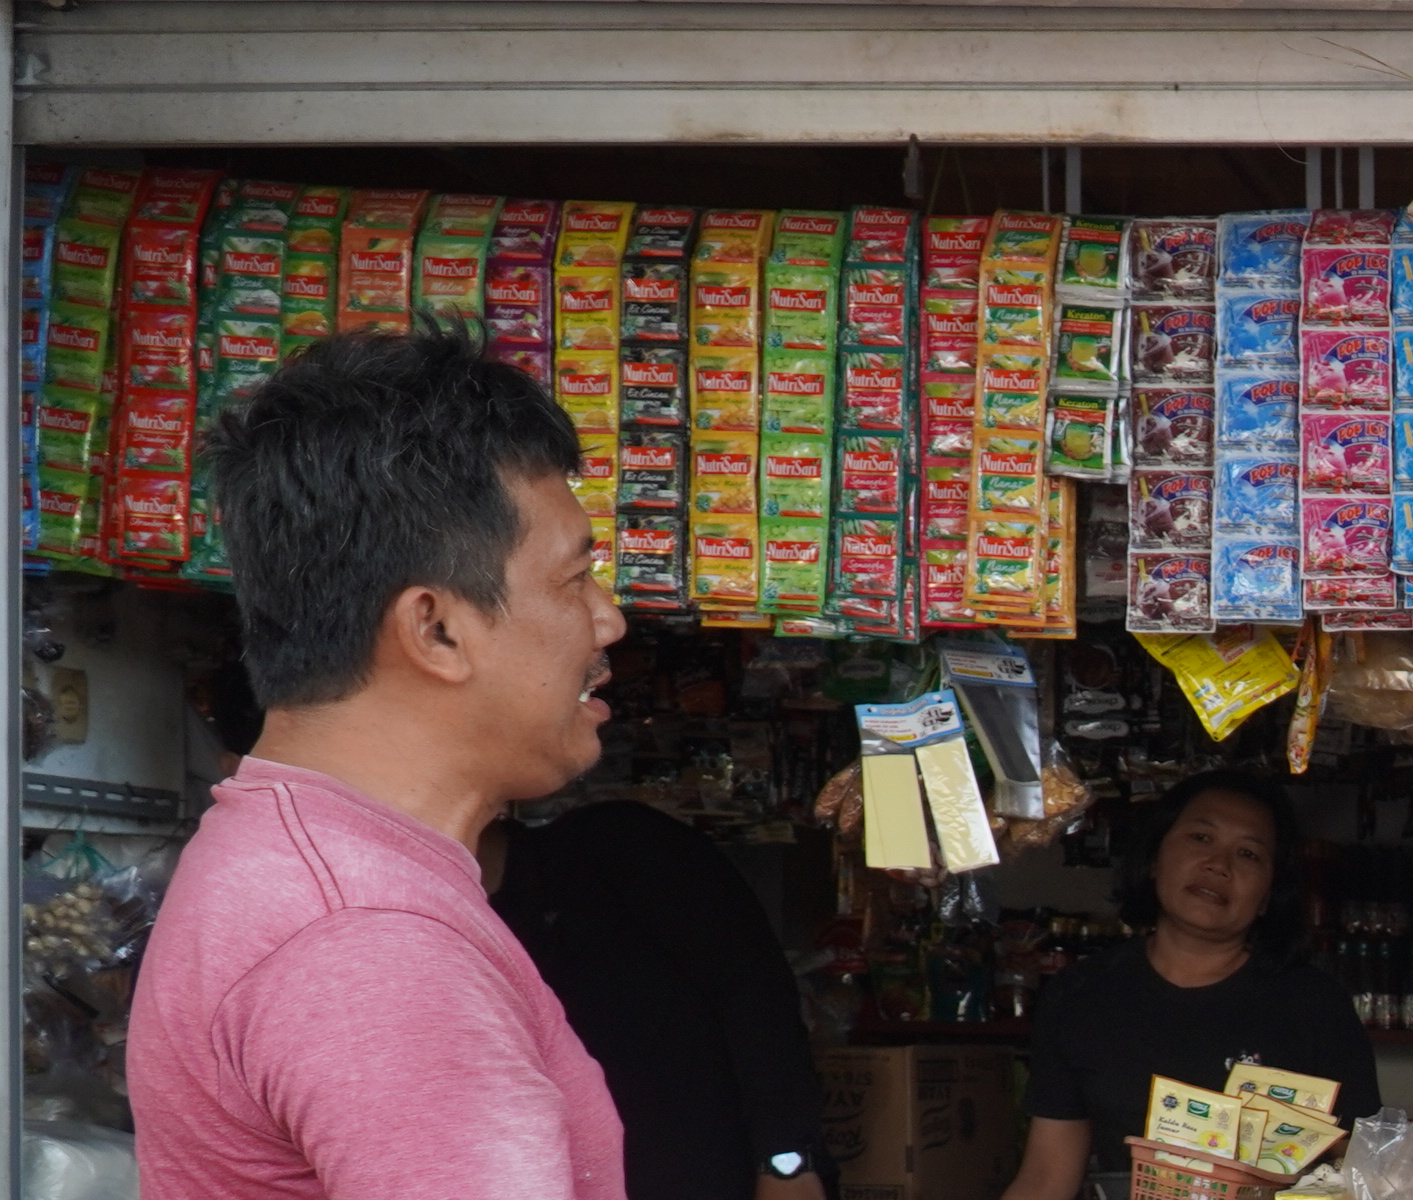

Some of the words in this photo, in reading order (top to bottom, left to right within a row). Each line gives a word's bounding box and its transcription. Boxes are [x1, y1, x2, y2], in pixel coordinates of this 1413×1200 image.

[930, 234, 982, 250] NutriSari
[224, 254, 276, 274] NutriSari
[351, 254, 400, 271] NutriSari
[424, 259, 474, 277] NutriSari
[770, 290, 823, 310] NutriSari
[220, 337, 275, 357] NutriSari
[624, 365, 675, 383] NutriSari
[767, 374, 821, 393] NutriSari
[984, 371, 1036, 390] NutriSari
[128, 411, 182, 432] NutriSari
[697, 454, 748, 473] NutriSari
[766, 457, 819, 476] NutriSari
[843, 453, 895, 472] NutriSari
[981, 454, 1034, 473] NutriSari
[124, 494, 177, 514] NutriSari
[696, 539, 751, 557] NutriSari
[978, 538, 1031, 557] NutriSari
